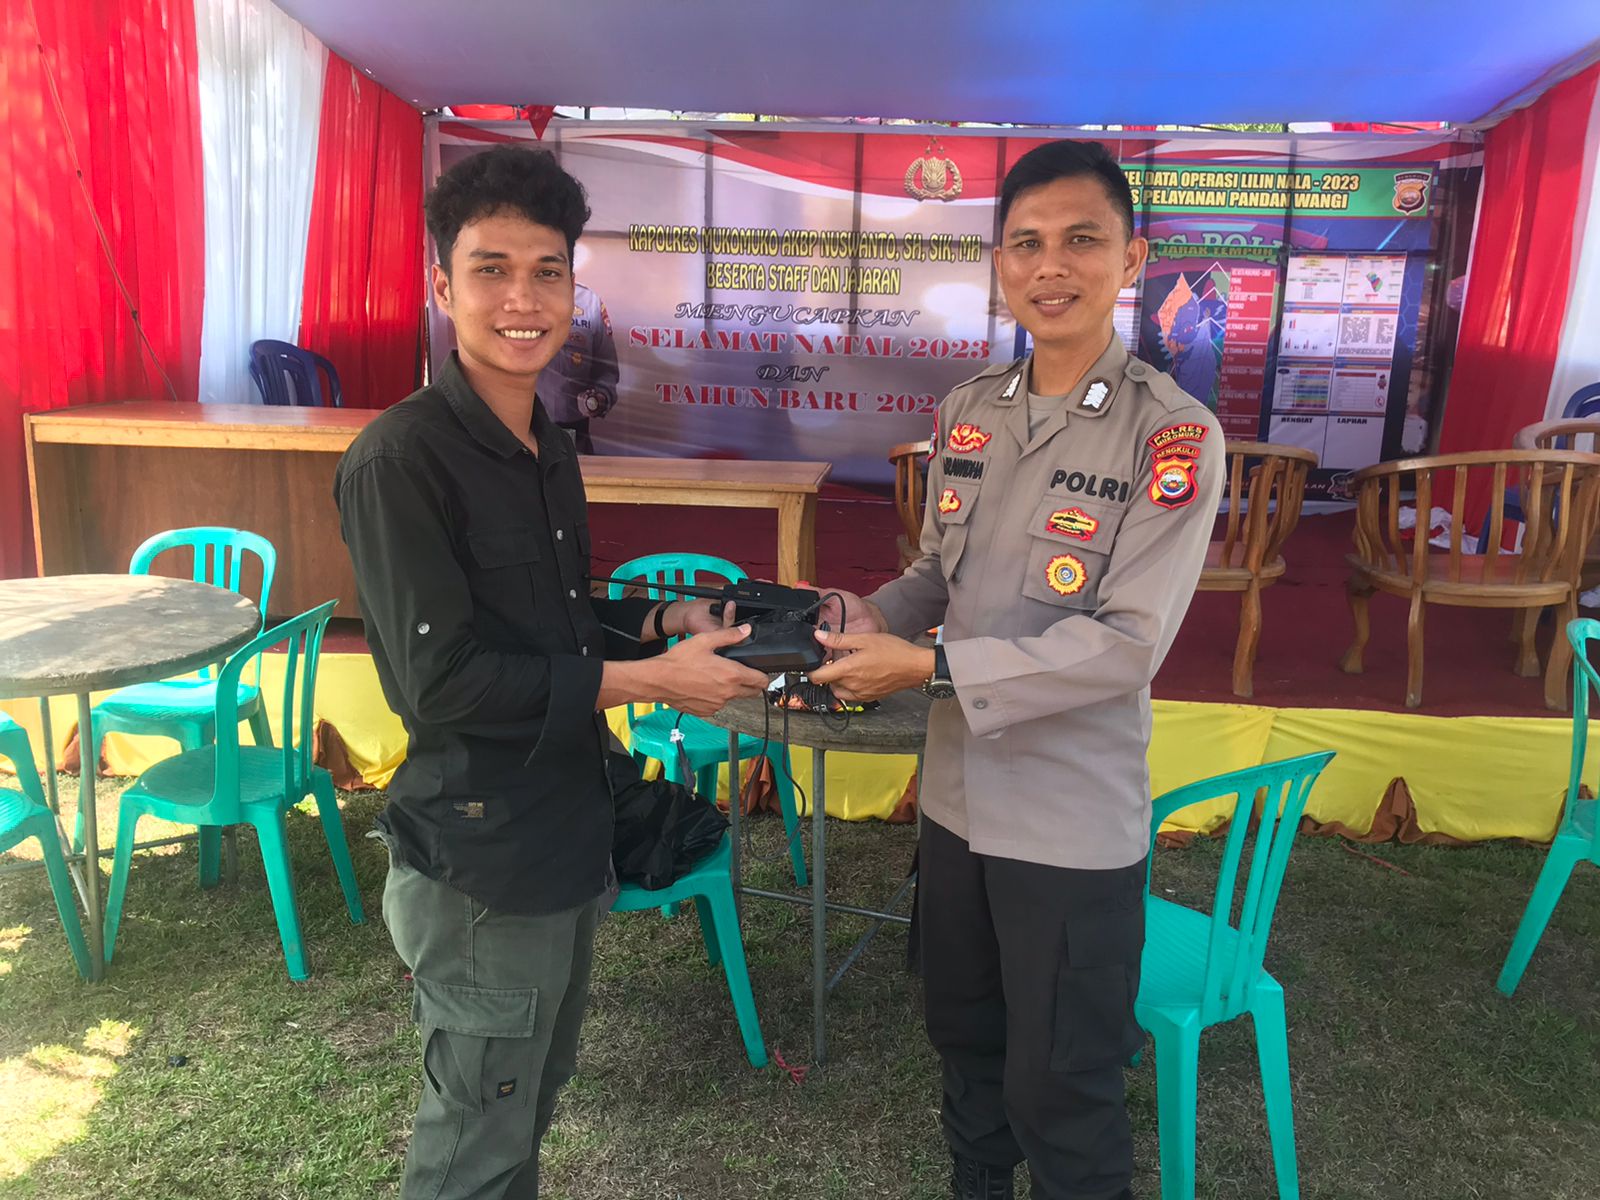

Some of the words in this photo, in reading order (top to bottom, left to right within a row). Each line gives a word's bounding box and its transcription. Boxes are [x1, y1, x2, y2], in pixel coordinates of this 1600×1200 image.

[1124, 170, 1142, 187] EL
[1143, 170, 1179, 187] DATA
[1180, 171, 1239, 189] OPERASI
[1240, 173, 1275, 190] LILIN
[1276, 174, 1312, 190] NALA
[1321, 174, 1360, 192] 2023
[1130, 188, 1140, 205] S
[1142, 189, 1227, 208] PELAYANAN
[1228, 191, 1290, 209] PANDAN
[1293, 193, 1348, 210] WANGI
[629, 224, 698, 253] KAPOLRES
[700, 226, 778, 256] MUKOMUKO
[781, 229, 818, 257] AKBP
[820, 230, 900, 261] NUSWANTO,
[903, 232, 926, 262] SH,
[928, 233, 956, 263] SIK,
[958, 234, 982, 262] MH
[706, 262, 766, 290] BESERTA
[768, 264, 810, 292] STAFF
[811, 266, 839, 293] DAN
[843, 267, 901, 295] JAJARAN
[675, 302, 920, 328] MENGUCAPKAN
[629, 325, 786, 353] SELAMAT
[793, 333, 903, 358] NATAL
[908, 335, 990, 360] 2023
[756, 365, 829, 382] DAN
[655, 383, 772, 408] TAHUN
[777, 387, 868, 411] BARU
[876, 392, 937, 415] 202
[1153, 425, 1203, 447] POLRES
[1050, 469, 1129, 503] POLRI
